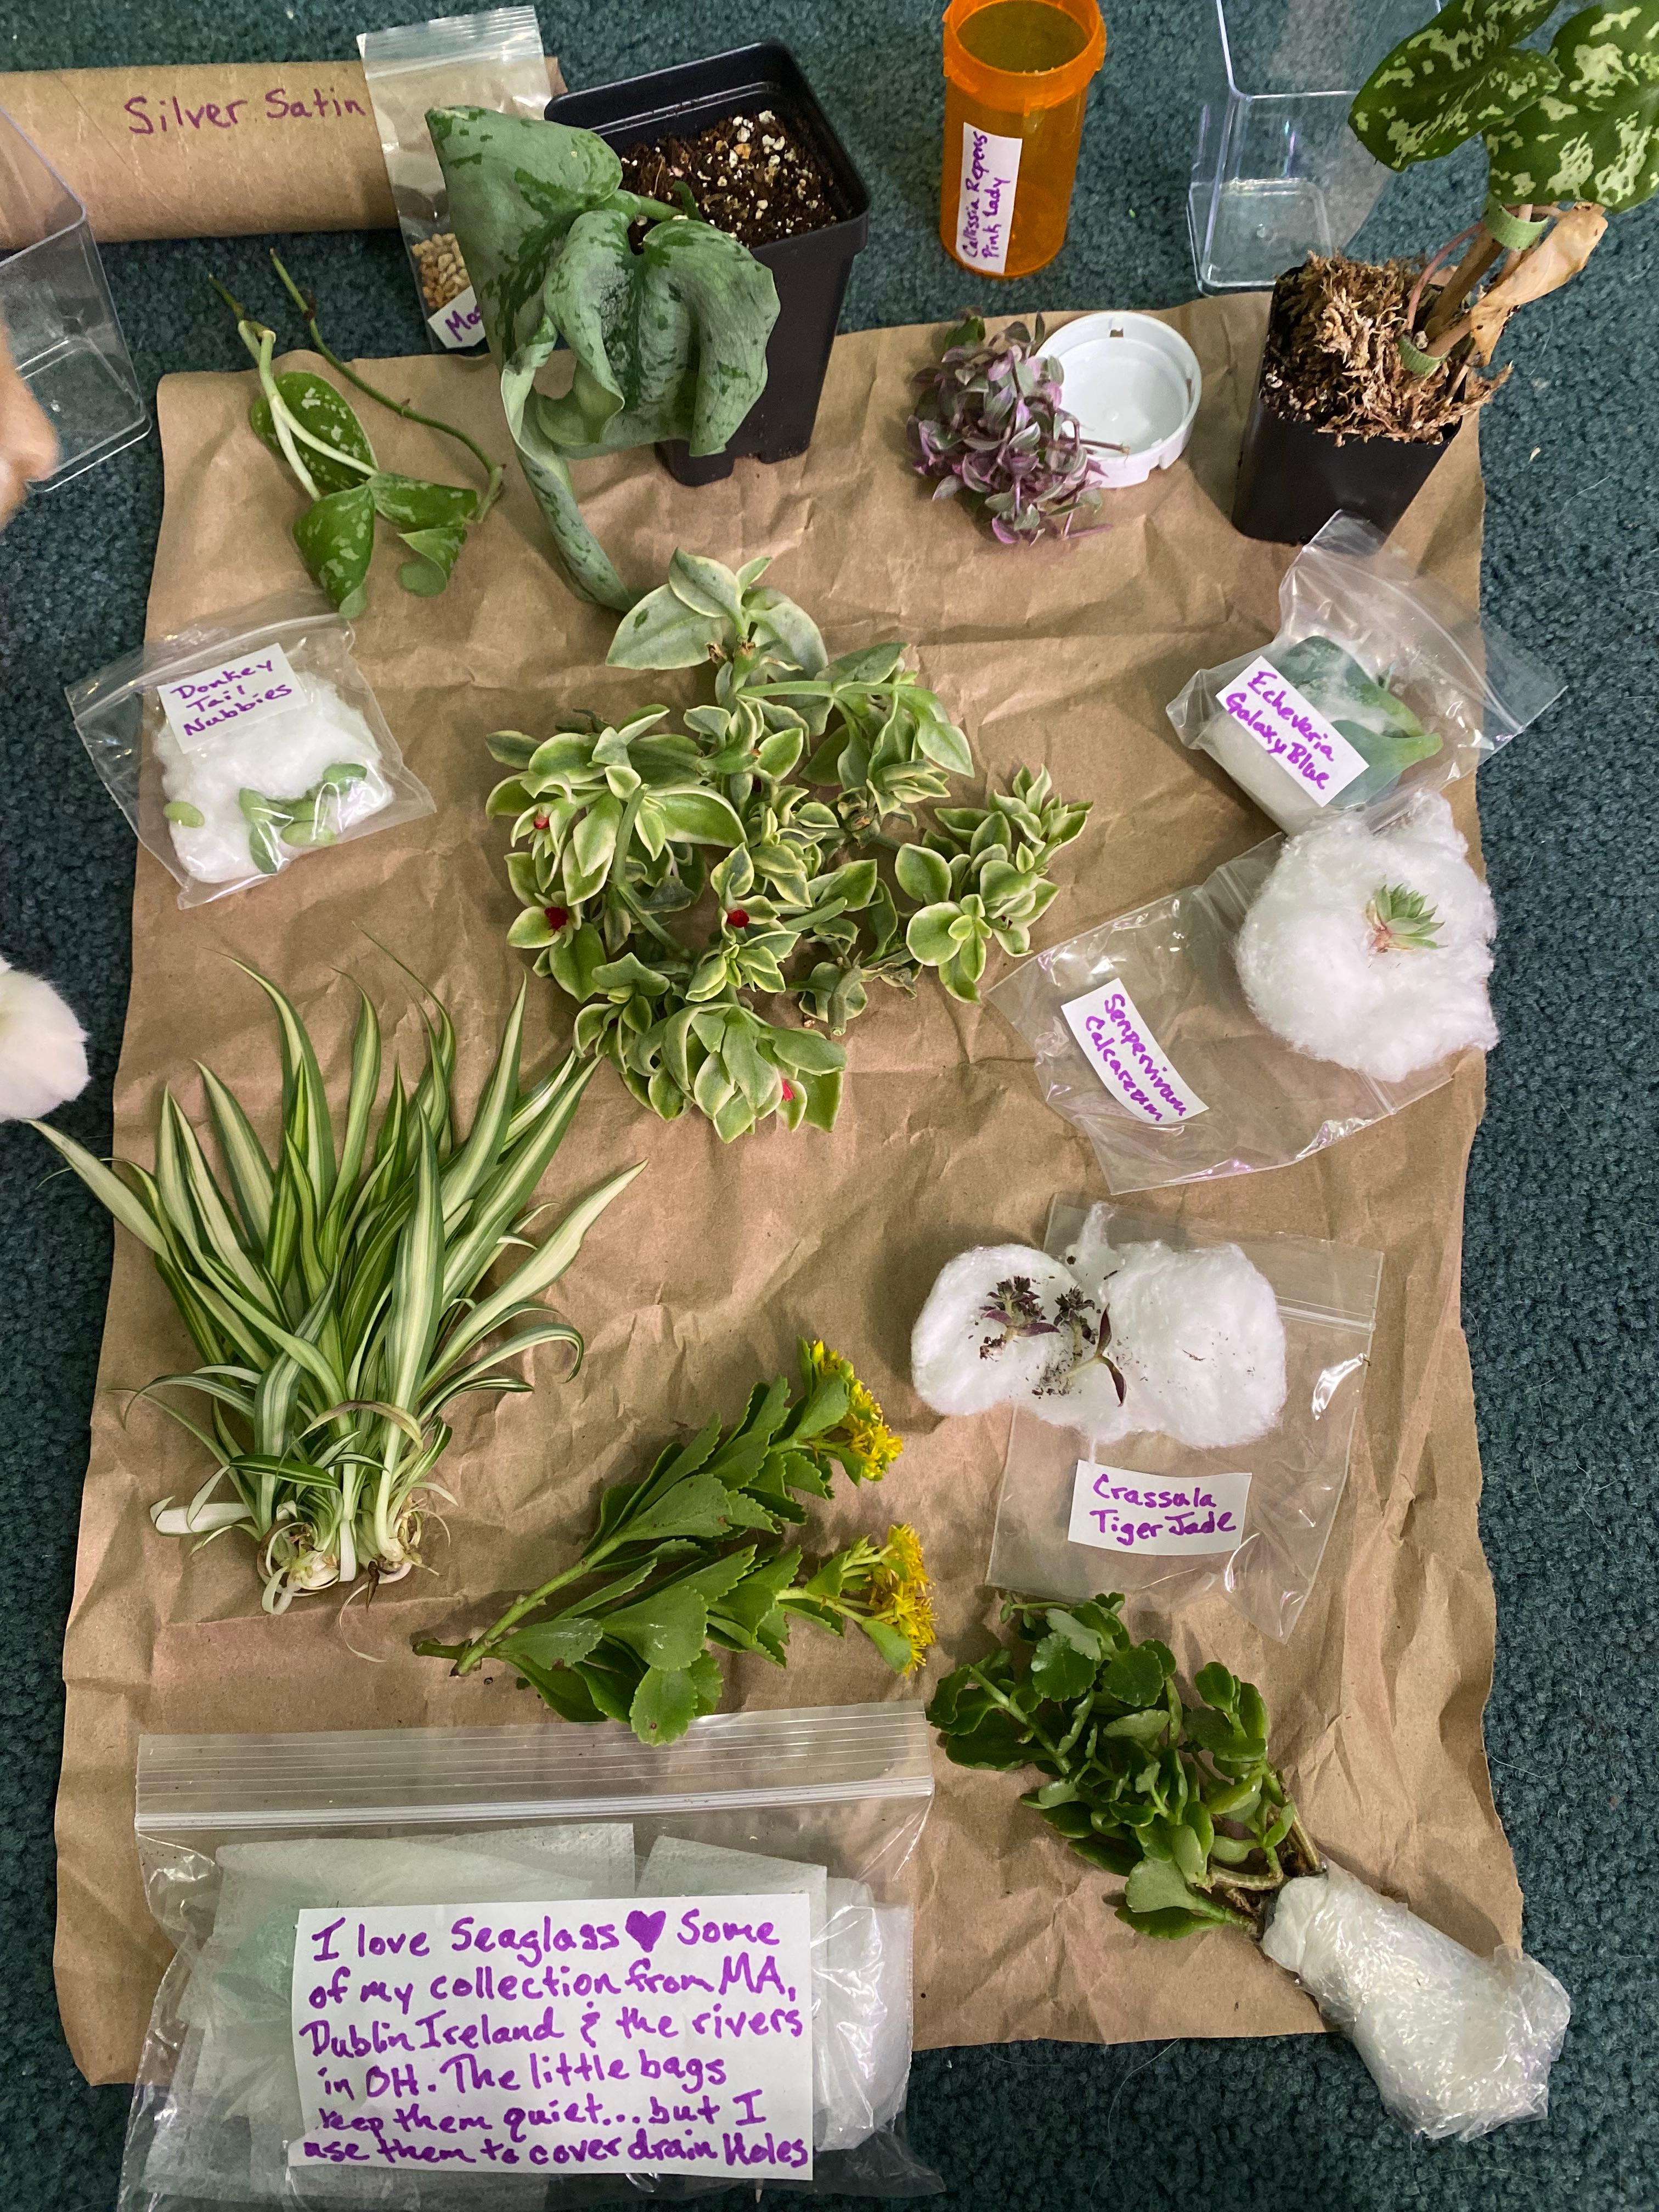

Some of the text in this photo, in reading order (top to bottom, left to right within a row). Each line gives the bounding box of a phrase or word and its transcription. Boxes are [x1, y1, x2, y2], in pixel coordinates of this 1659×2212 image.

[124, 88, 366, 134] Silver Satin
[982, 177, 1011, 258] Pink Lady
[170, 660, 273, 699] Donkey
[186, 685, 245, 712] Tail
[183, 684, 292, 736] Nubbies
[1248, 671, 1334, 761] Echeveria
[1226, 692, 1329, 789] Galaxy Blue
[1093, 1474, 1217, 1508] Crassula
[1089, 1509, 1237, 1546] Tiger Jade
[312, 1908, 780, 1967] I love Seaglass Some
[309, 1953, 796, 2015] of my collection from MA,
[299, 2020, 415, 2058] Dublin
[415, 2006, 565, 2049] Ireland
[616, 2006, 679, 2039] the
[692, 2003, 803, 2039] rivers
[317, 2049, 726, 2100] in OH. The little bags
[319, 2108, 383, 2138] keep
[393, 2103, 492, 2133] them
[732, 2089, 766, 2125] I
[304, 2128, 808, 2167] use them to cover drain Holes
